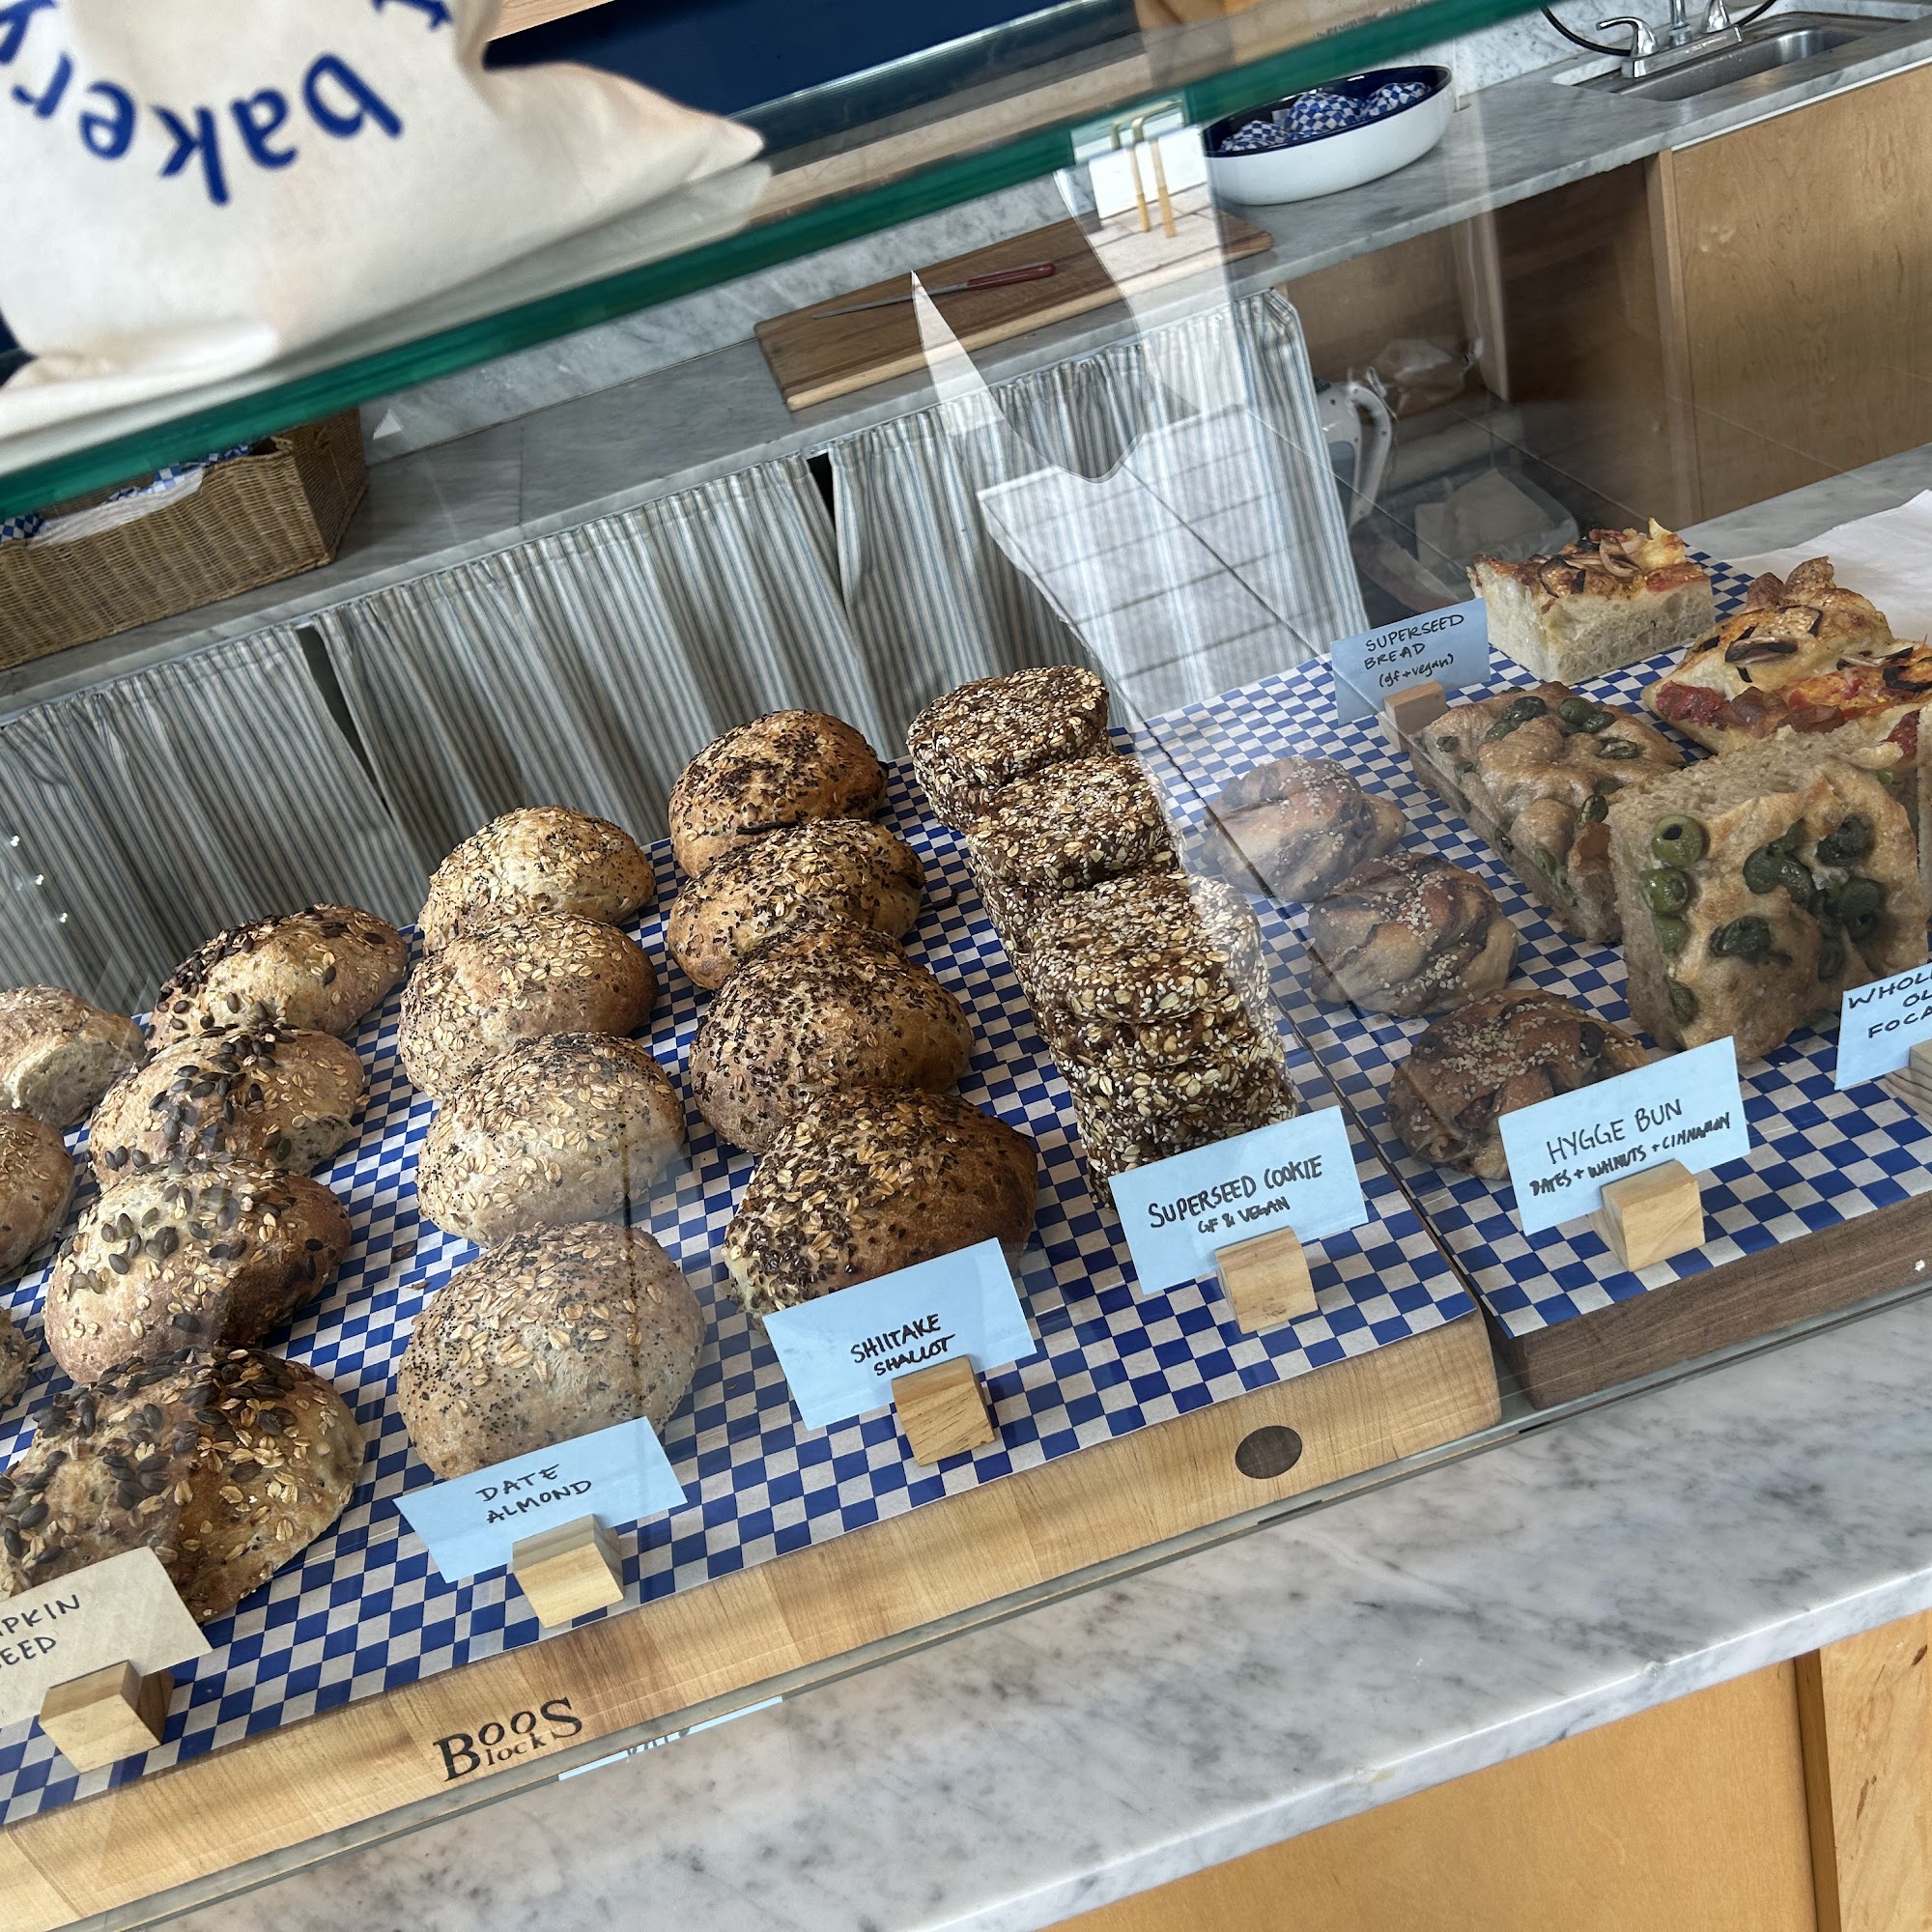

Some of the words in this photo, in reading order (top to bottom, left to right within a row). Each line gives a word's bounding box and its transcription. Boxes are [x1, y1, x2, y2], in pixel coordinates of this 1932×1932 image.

[1366, 615, 1463, 651] SUPERSEED
[1365, 643, 1425, 669] BREAD
[1848, 969, 1932, 1009] WHOL
[1547, 1120, 1625, 1164] HYGGE
[1634, 1099, 1682, 1131] BUN
[1149, 1176, 1256, 1228] SUPERSEED
[1264, 1155, 1321, 1188] COOKIE
[1529, 1169, 1572, 1196] DATES
[1198, 1217, 1219, 1234] GF
[1221, 1212, 1236, 1228] &
[1237, 1196, 1291, 1223] VEGAN
[851, 1314, 940, 1363] SHIITAKE
[874, 1334, 955, 1376] SHALLOT
[476, 1464, 558, 1501] DATE
[488, 1481, 591, 1522] ALMOND
[0, 1595, 79, 1635] PKIN
